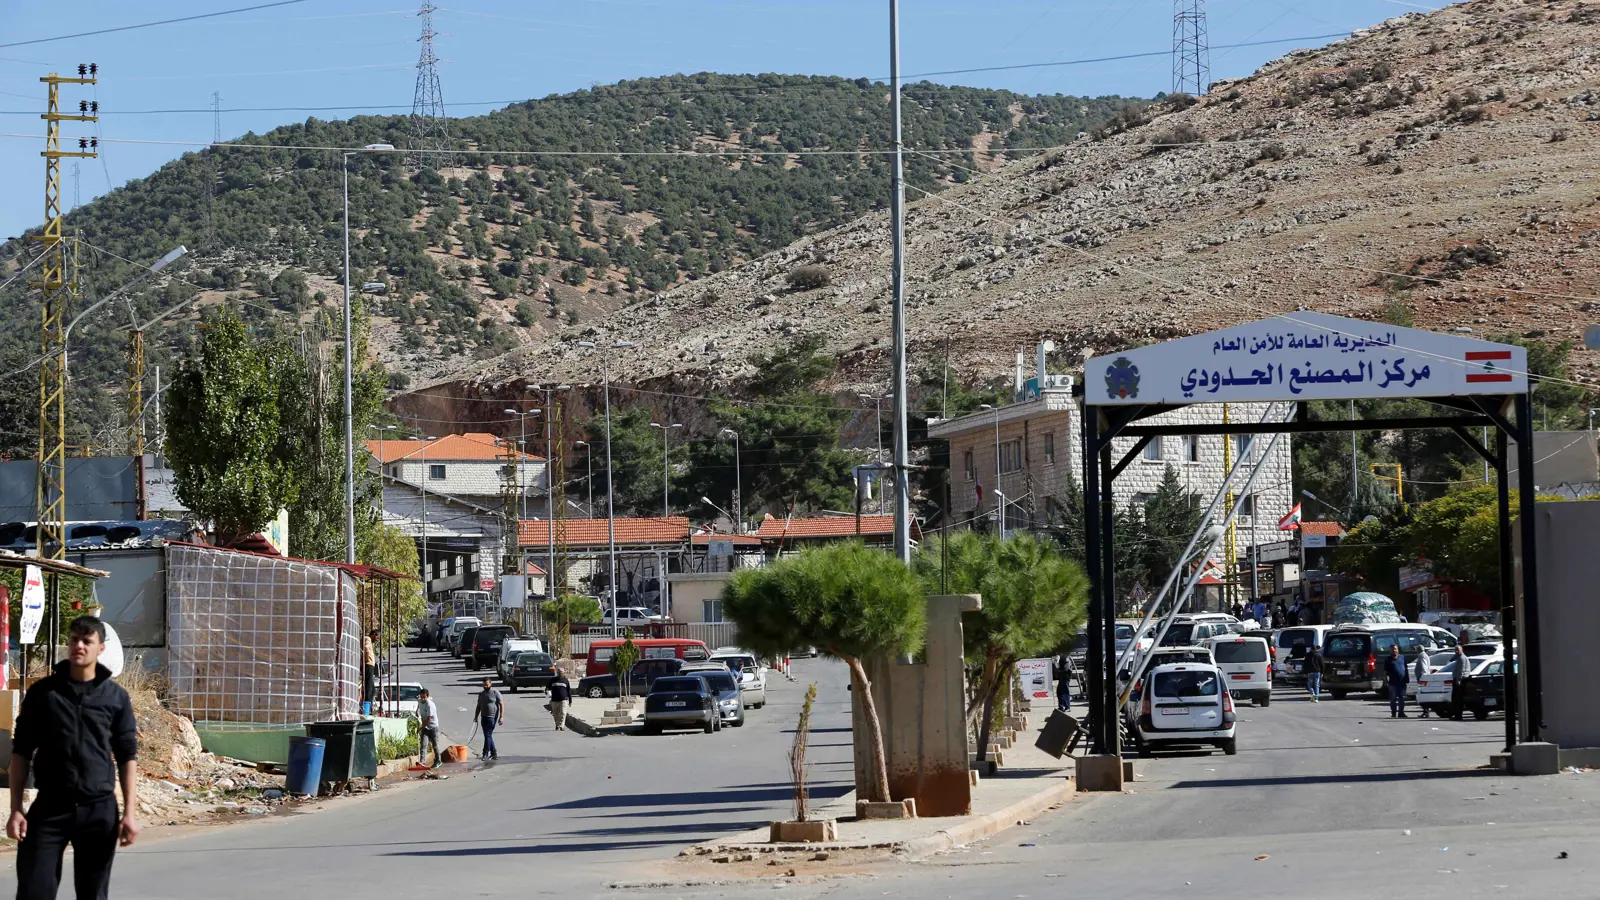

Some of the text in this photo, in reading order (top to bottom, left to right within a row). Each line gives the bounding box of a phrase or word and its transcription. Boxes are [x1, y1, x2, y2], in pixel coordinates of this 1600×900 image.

[1213, 332, 1396, 355] المديرية العامة للأمن العام
[1180, 357, 1431, 398] مركز المصنع الحدودي
